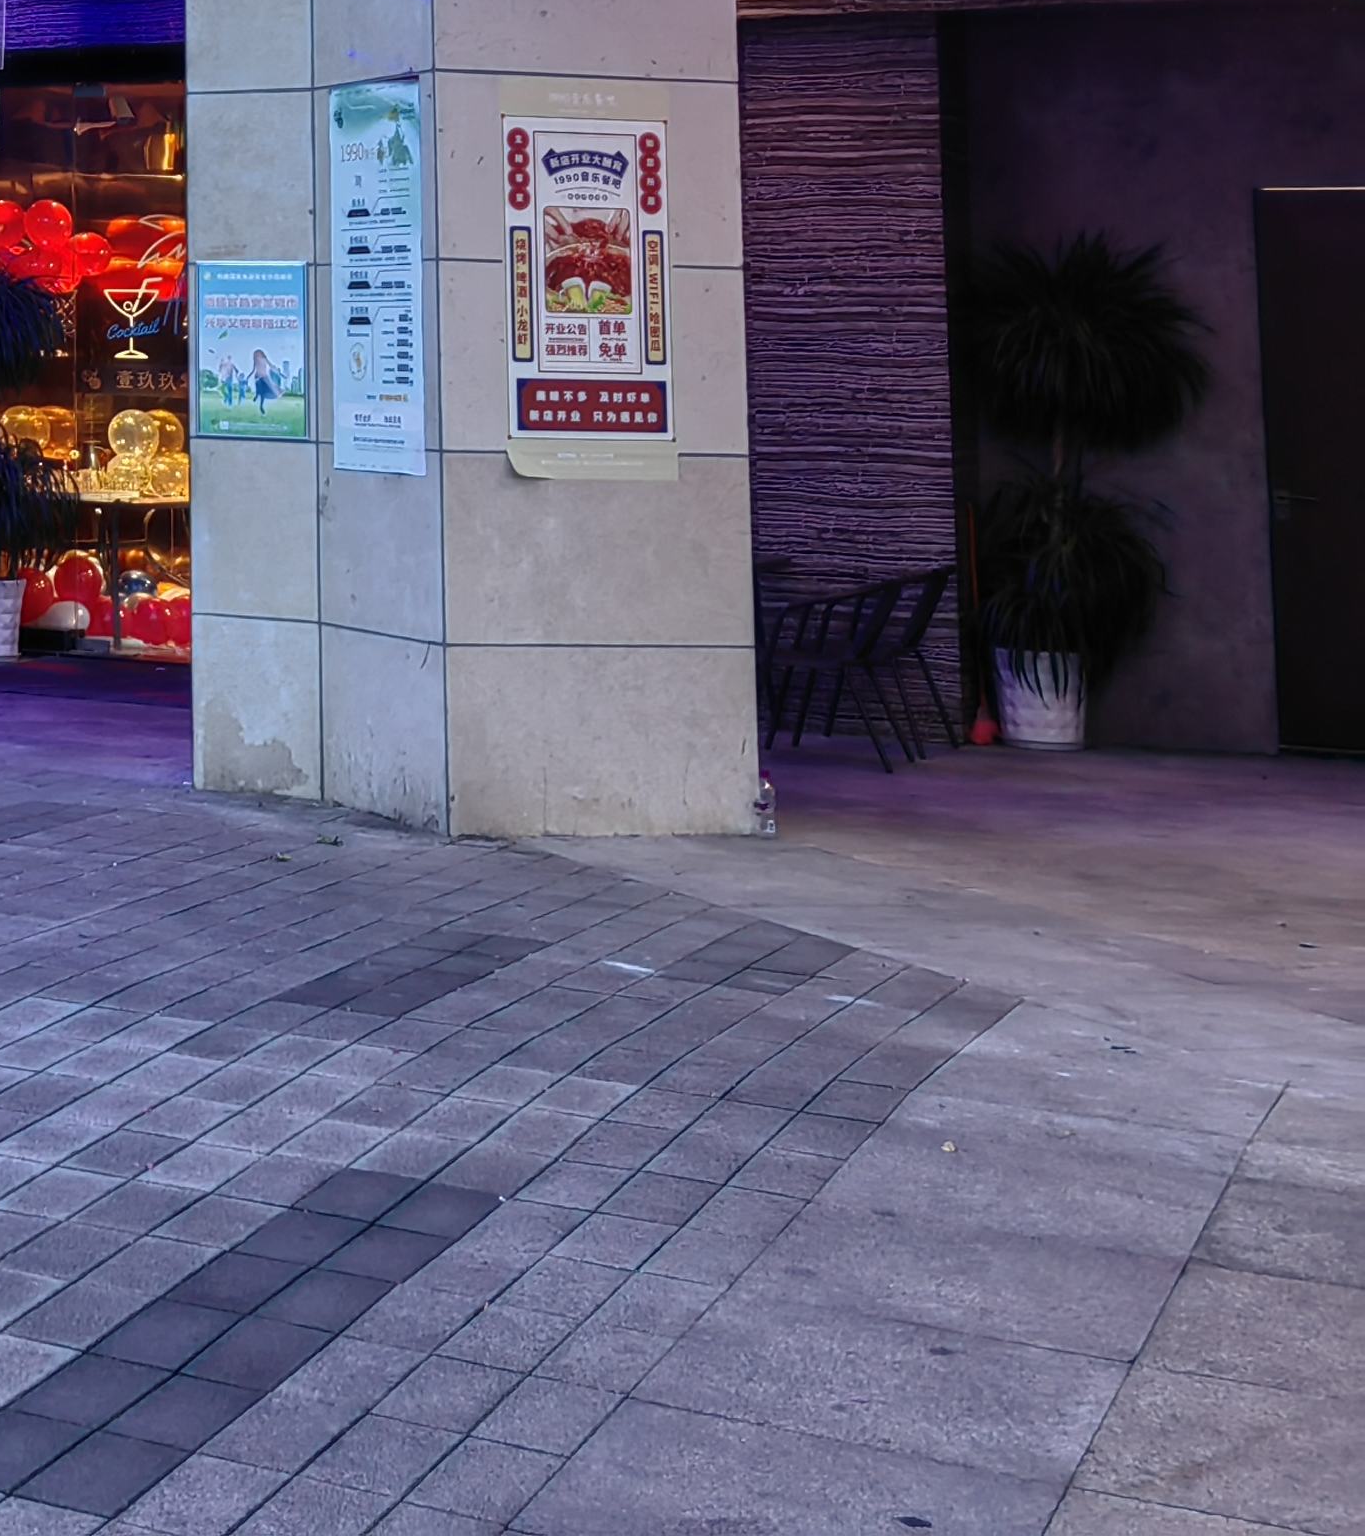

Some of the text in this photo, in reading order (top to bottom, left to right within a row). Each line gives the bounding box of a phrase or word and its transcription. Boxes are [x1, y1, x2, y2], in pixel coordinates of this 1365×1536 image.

[554, 171, 622, 190] 1990音乐餐吧
[107, 319, 161, 340] Cocktail
[545, 322, 588, 336] 开业公告
[598, 341, 627, 358] 免单
